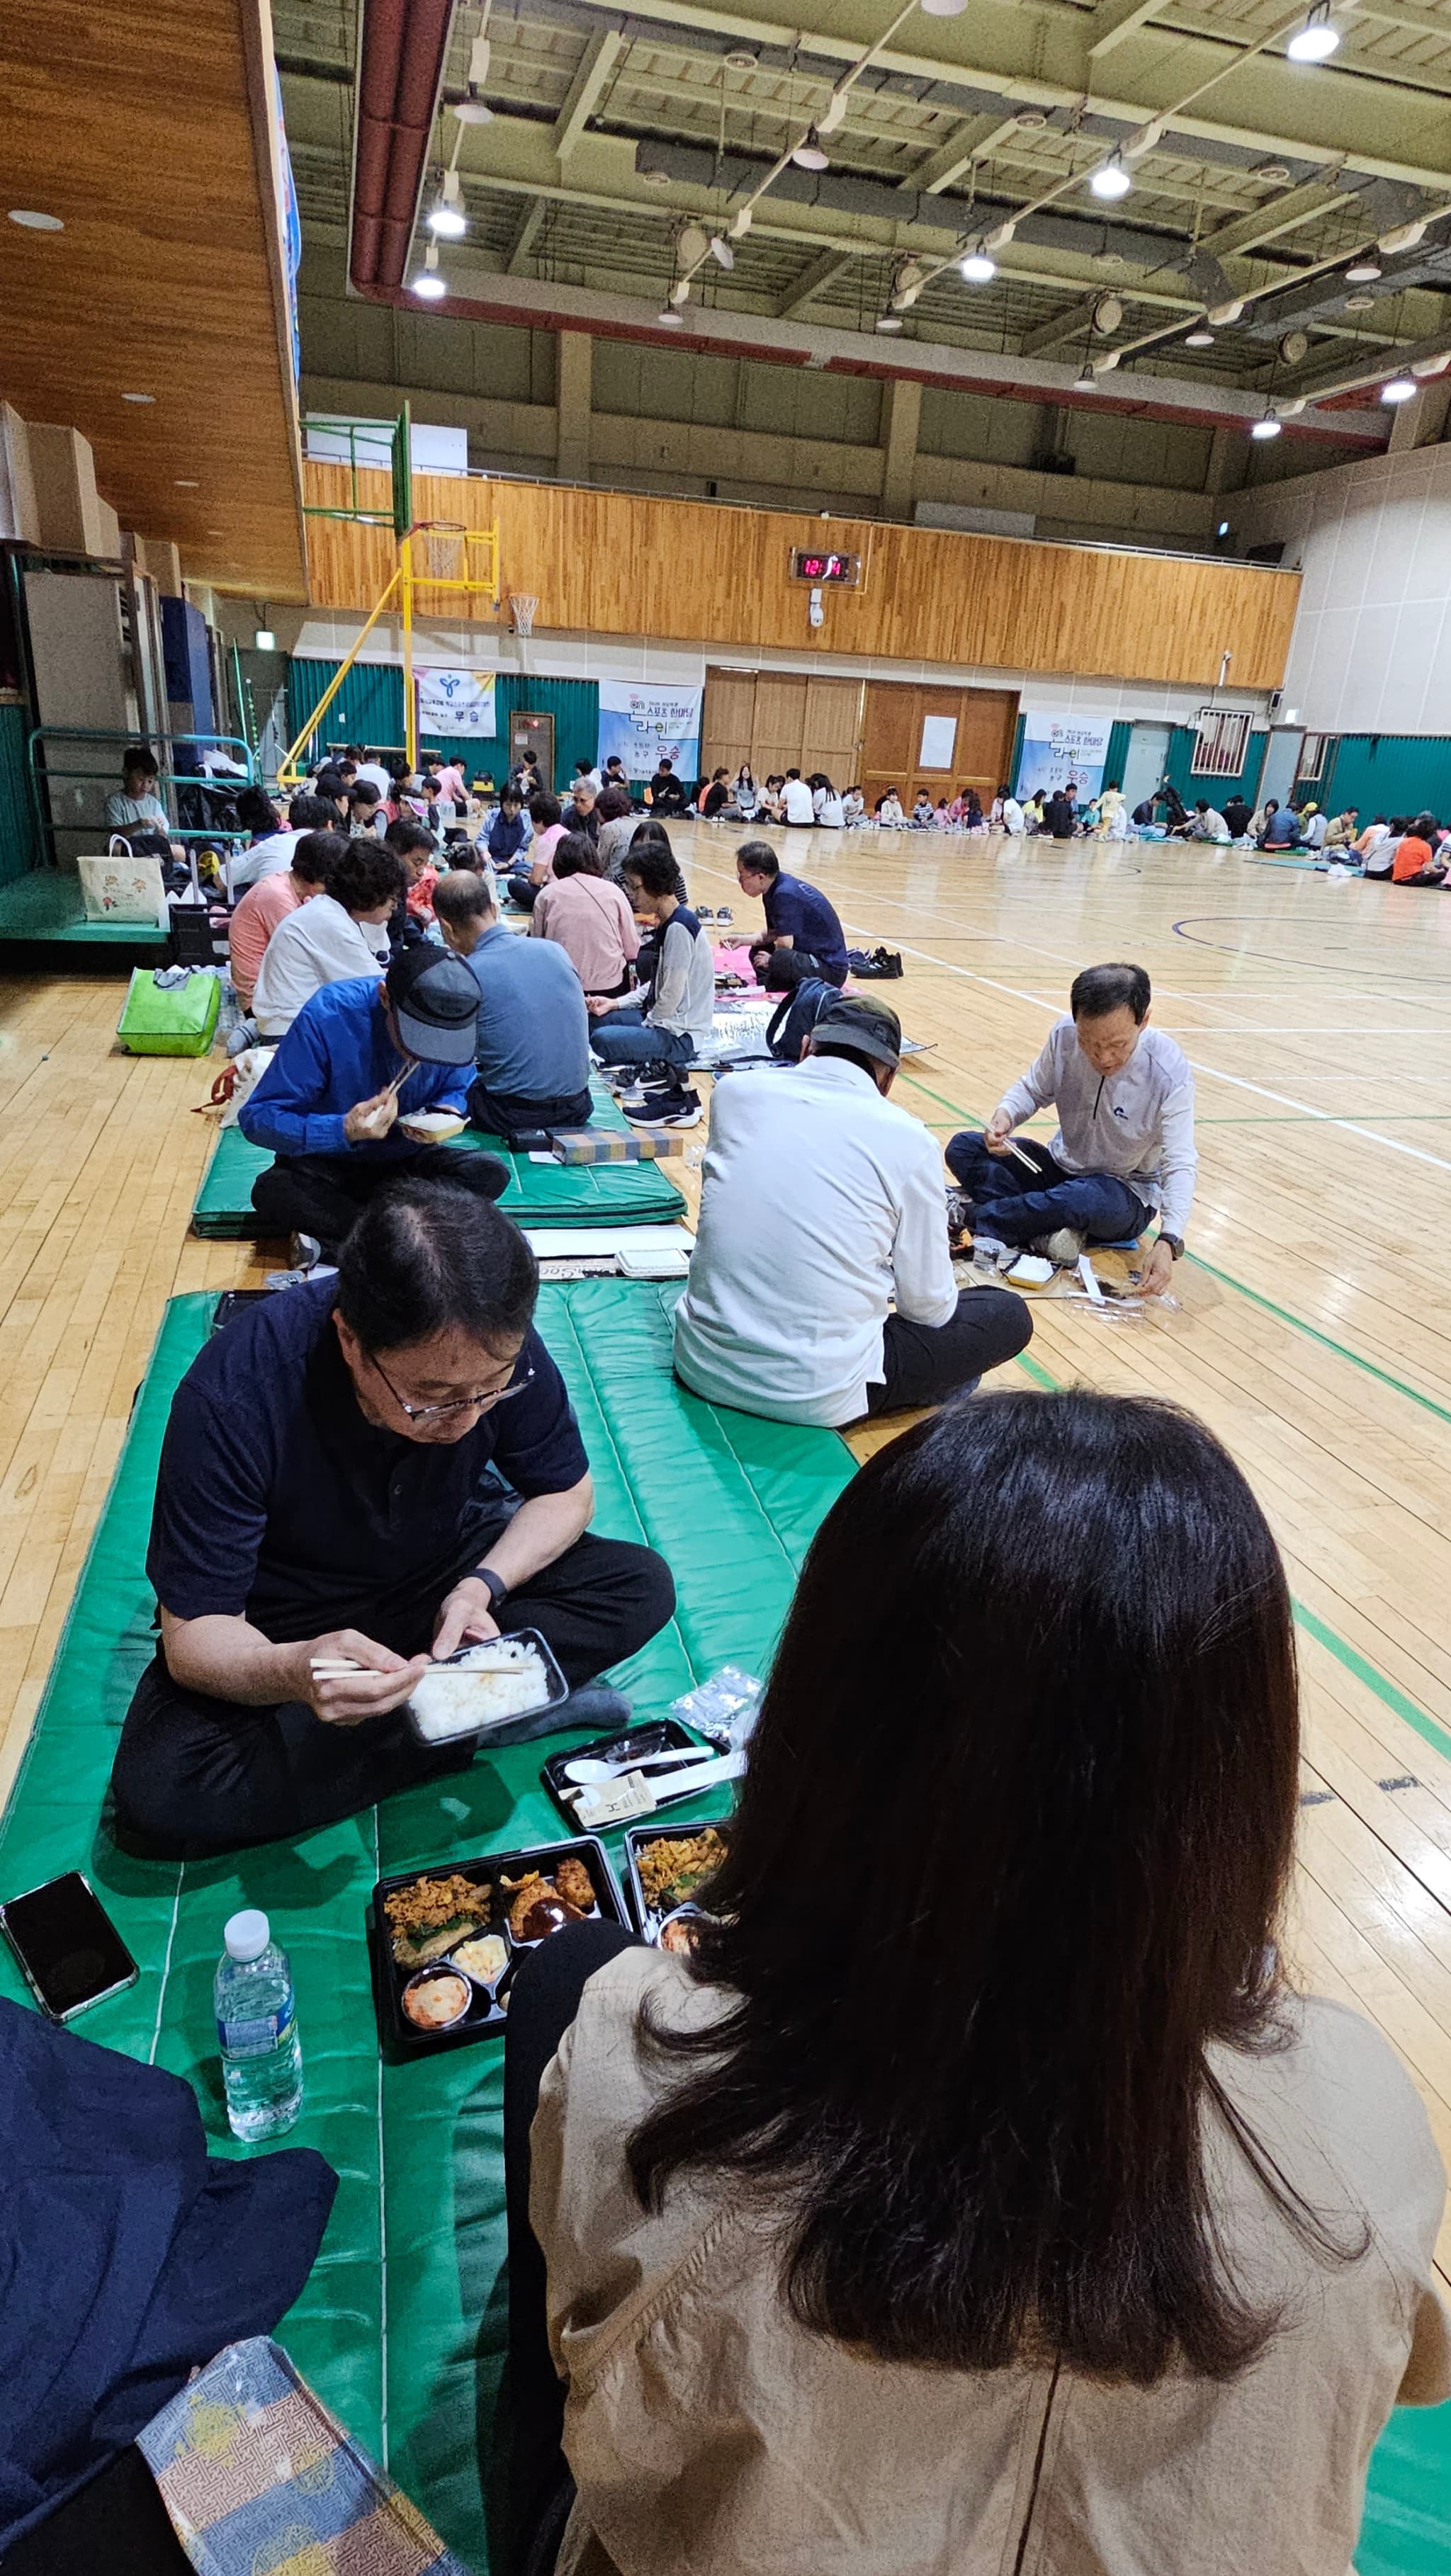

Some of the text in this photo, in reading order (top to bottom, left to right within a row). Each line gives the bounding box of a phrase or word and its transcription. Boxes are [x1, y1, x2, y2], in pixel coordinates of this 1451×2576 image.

[647, 707, 668, 717] 스포츠
[655, 745, 680, 760] 우승
[1066, 770, 1088, 784] 우승
